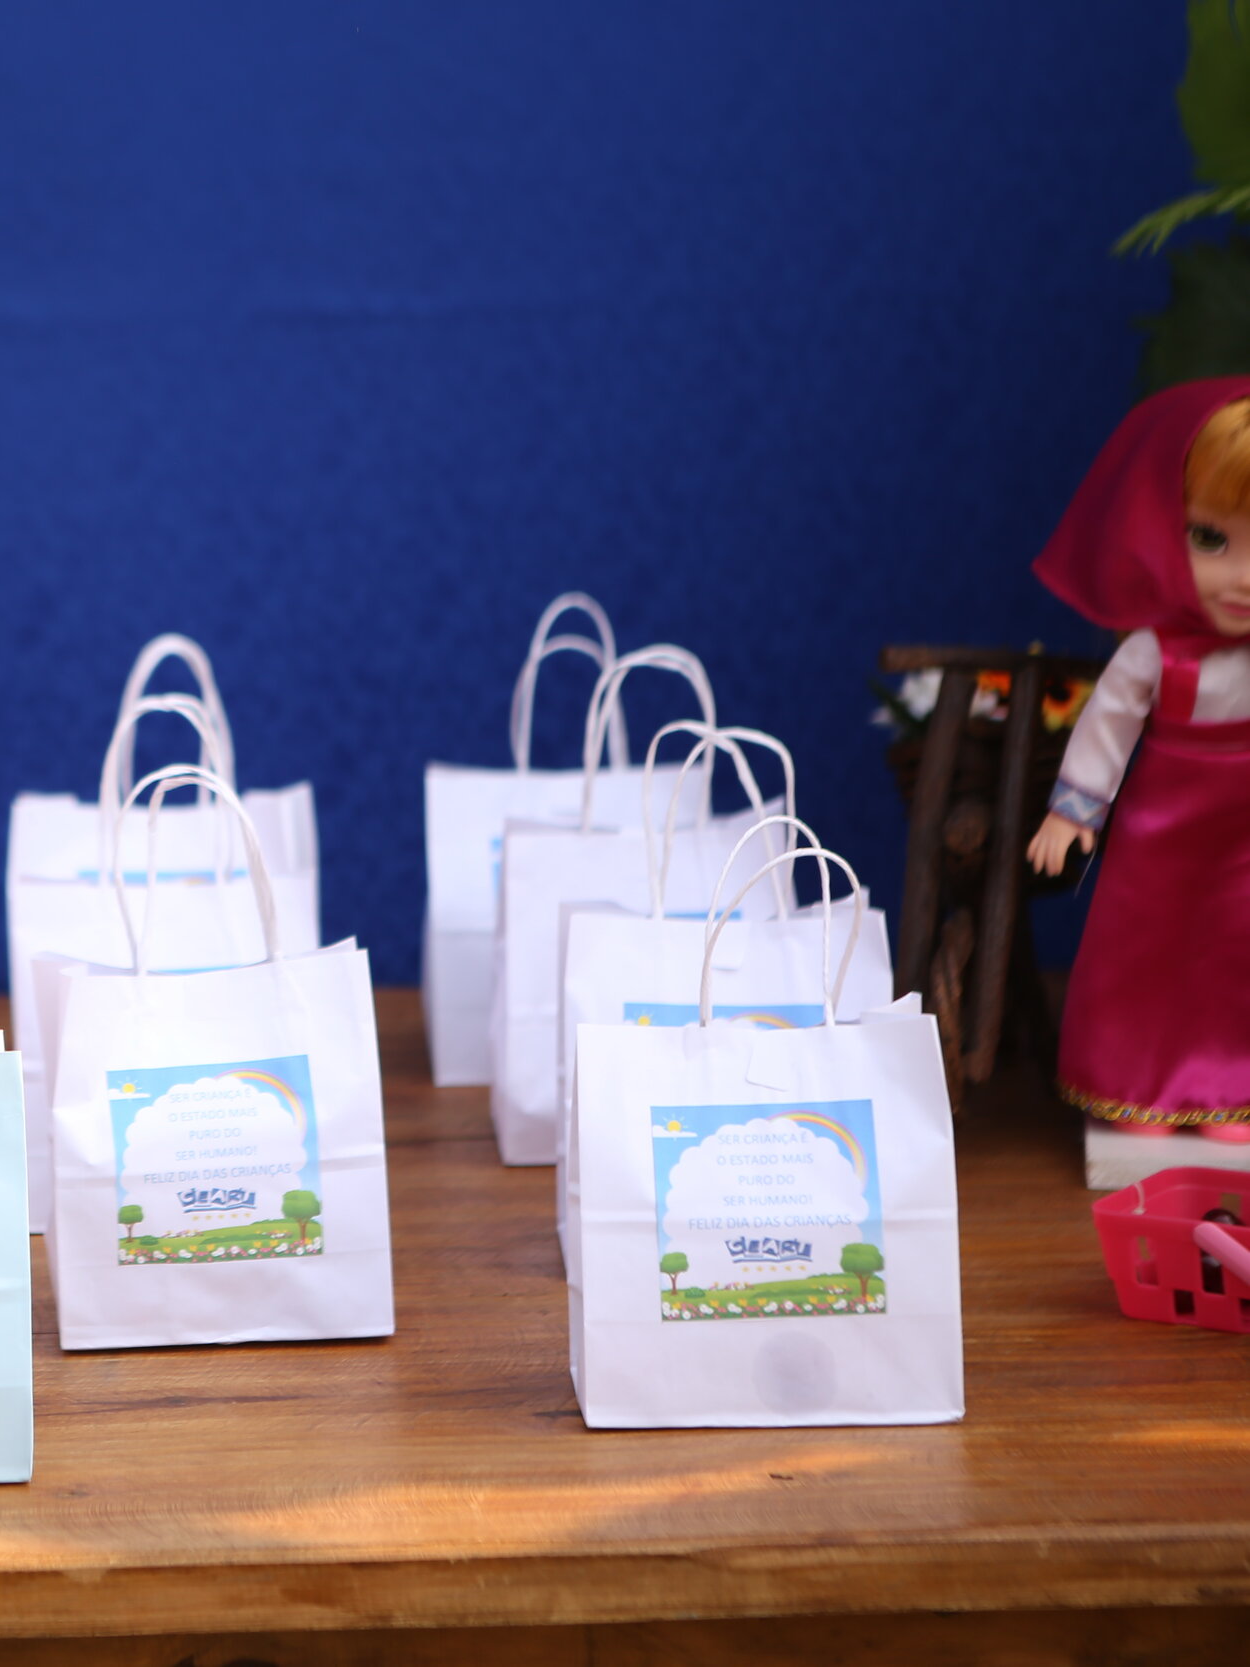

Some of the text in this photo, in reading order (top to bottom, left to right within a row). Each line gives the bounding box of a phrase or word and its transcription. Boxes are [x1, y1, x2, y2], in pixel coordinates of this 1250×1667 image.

[718, 1134, 741, 1145] SER
[744, 1134, 798, 1147] CRIANÇA
[730, 1155, 779, 1166] ESTADO
[782, 1153, 814, 1165] MAIS
[738, 1174, 795, 1186] PURO DO
[723, 1194, 813, 1207] SER HUMANO!
[689, 1214, 852, 1230] FELIZ DIA DAS CRIANÇAS
